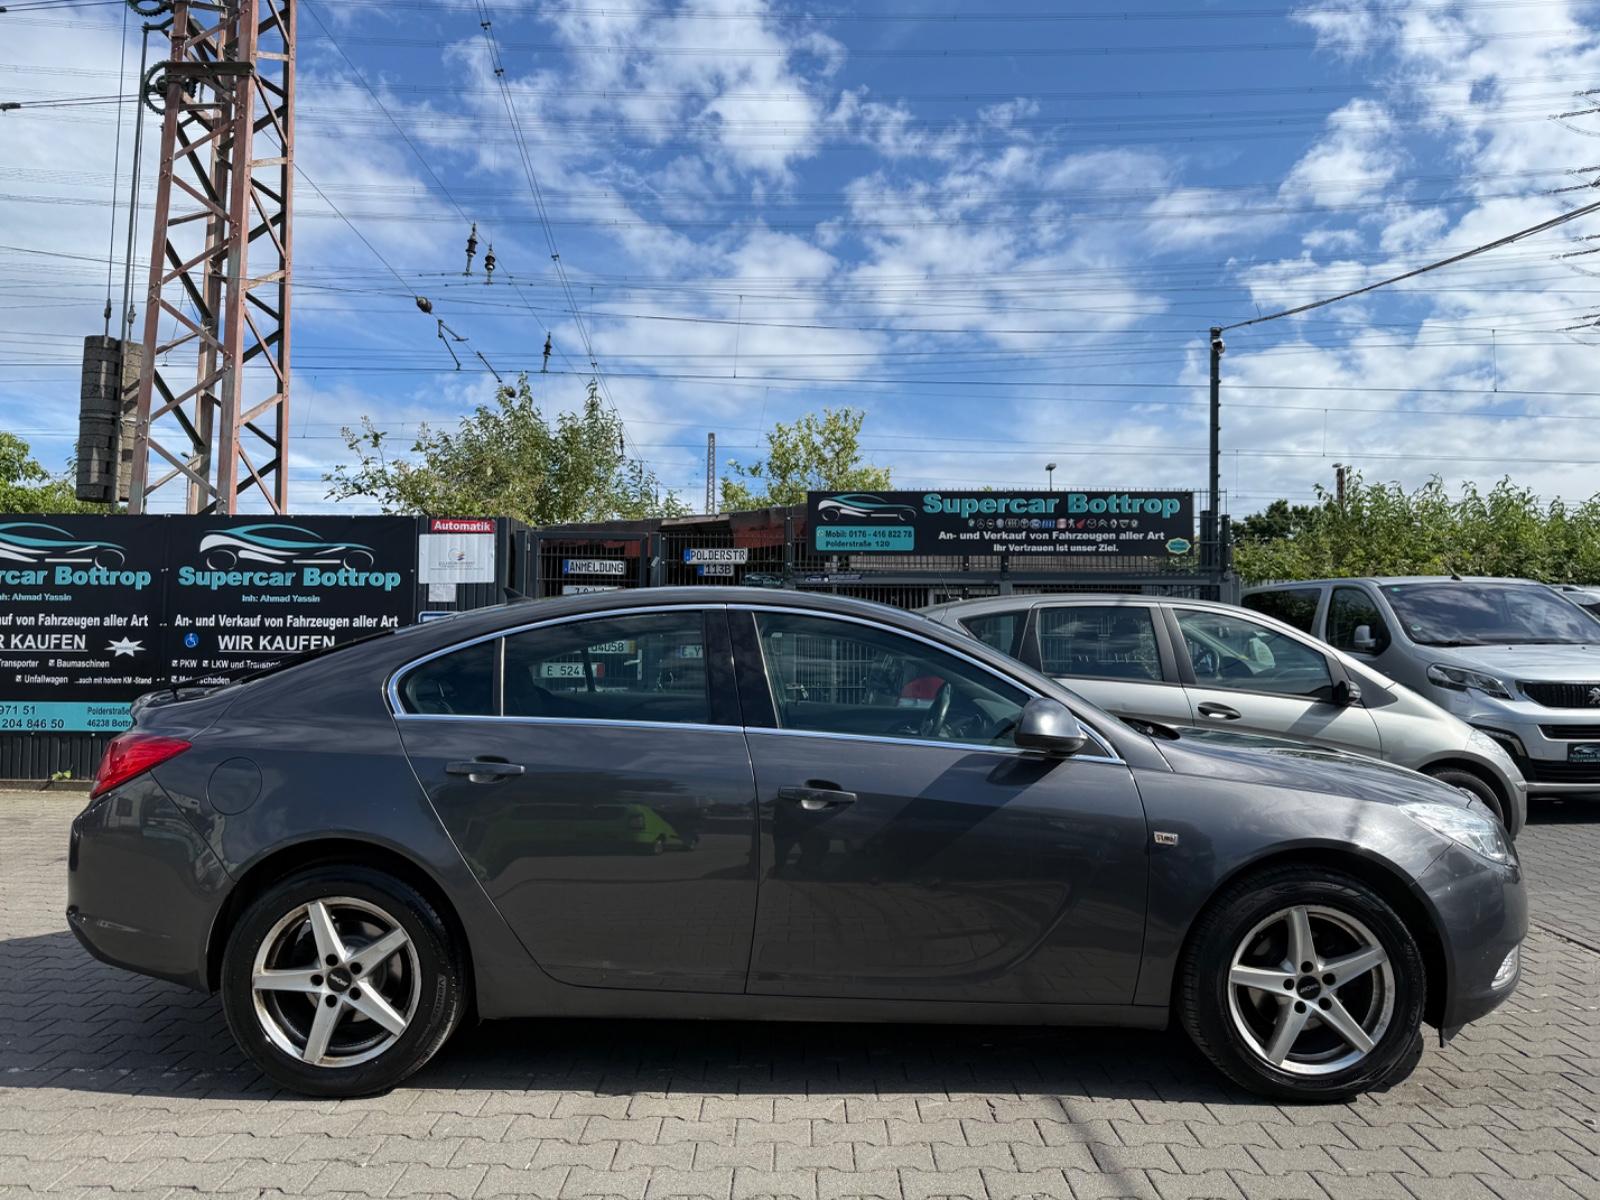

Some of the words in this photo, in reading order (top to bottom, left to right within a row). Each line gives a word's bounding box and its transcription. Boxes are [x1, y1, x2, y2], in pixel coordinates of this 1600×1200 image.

[922, 493, 1059, 518] Supercar
[1067, 493, 1180, 519] Bottrop
[434, 520, 491, 531] Automatik
[938, 531, 957, 540] An-
[959, 531, 980, 540] und
[983, 531, 1026, 540] Verkauf
[1029, 532, 1049, 540] von
[1052, 531, 1116, 542] Fahrzeugen
[1119, 531, 1144, 540] aller
[1147, 531, 1165, 540] Art
[993, 543, 1007, 552] Ihr
[1008, 543, 1054, 552] Vertrauen
[1056, 543, 1068, 552] ist
[1070, 544, 1097, 552] unser
[1098, 543, 1119, 552] Ziel.
[690, 550, 746, 561] POLDERSTR
[569, 561, 624, 573] ANMELDUNG
[705, 564, 732, 575] 113B
[54, 565, 152, 590] Bottrop
[178, 566, 296, 590] Supercar
[303, 567, 401, 591] Bottrop
[12, 593, 42, 601] Ahmad
[44, 593, 72, 601] Yassin
[242, 594, 258, 602] Inh:
[292, 595, 320, 603] Yassin
[0, 613, 13, 626] uf
[16, 616, 35, 626] von
[38, 613, 100, 629] Fahrzeugen
[103, 614, 128, 626] aller
[130, 614, 149, 627] Art
[174, 614, 193, 627] An-
[195, 614, 216, 627] und
[218, 614, 262, 627] Verkauf
[264, 617, 284, 628] von
[286, 615, 350, 631] Fahrzeugen
[352, 615, 378, 628] aller
[380, 615, 399, 628] Art
[10, 634, 86, 649] KAUFEN
[218, 635, 253, 650] WIR
[259, 635, 336, 651] KAUFEN
[56, 659, 110, 668] Baumaschinen
[179, 660, 198, 668] PKW
[211, 660, 230, 669] LKW
[230, 661, 244, 669] und
[24, 674, 68, 685] Unfallwagen
[23, 705, 36, 715] 51
[2, 718, 22, 728] 204
[26, 718, 47, 728] 846
[50, 718, 65, 728] 50
